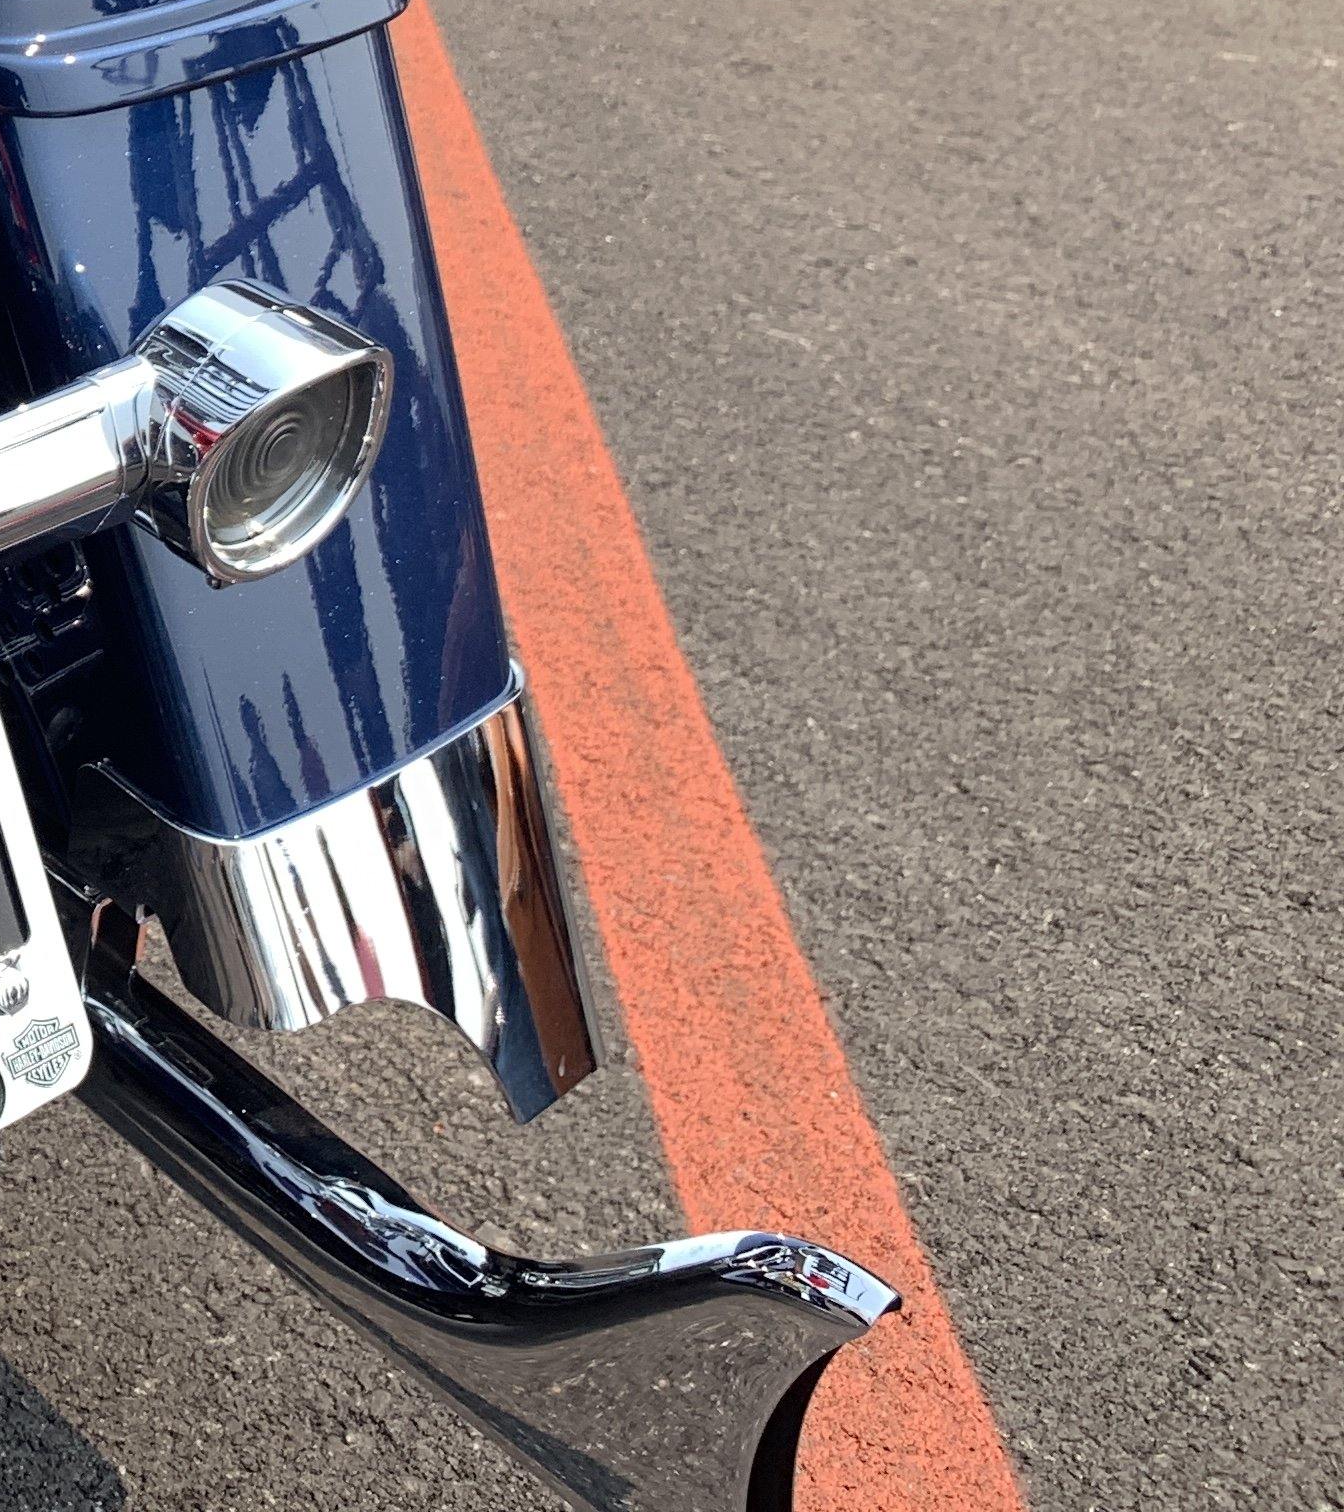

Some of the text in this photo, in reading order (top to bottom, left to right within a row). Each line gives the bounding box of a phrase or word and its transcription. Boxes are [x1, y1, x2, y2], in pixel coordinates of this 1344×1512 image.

[20, 1025, 54, 1048] MOTOR
[13, 1031, 73, 1070] HARLEY-DAVIDSON
[32, 1055, 64, 1080] CYCLES
